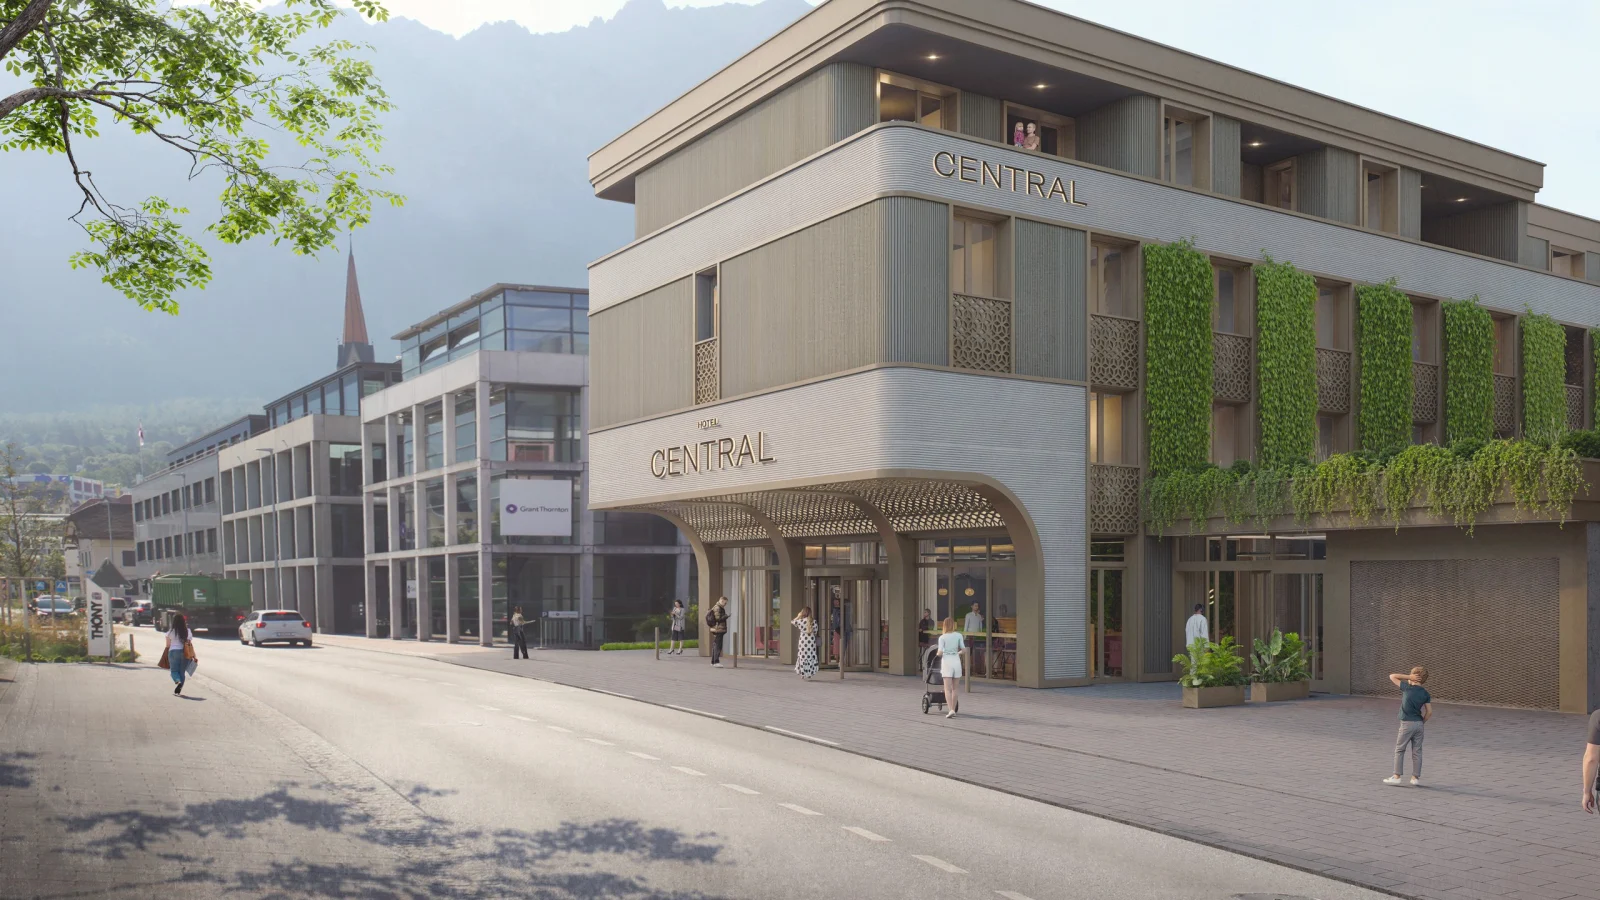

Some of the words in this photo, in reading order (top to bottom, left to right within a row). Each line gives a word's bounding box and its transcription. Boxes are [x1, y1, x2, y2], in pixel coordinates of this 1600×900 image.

[933, 151, 1087, 207] CENTRAL
[696, 418, 720, 429] HOTEL
[651, 431, 775, 478] CENTRAL
[520, 505, 539, 513] Grant
[540, 505, 569, 513] Thornton
[90, 601, 103, 640] THONY
